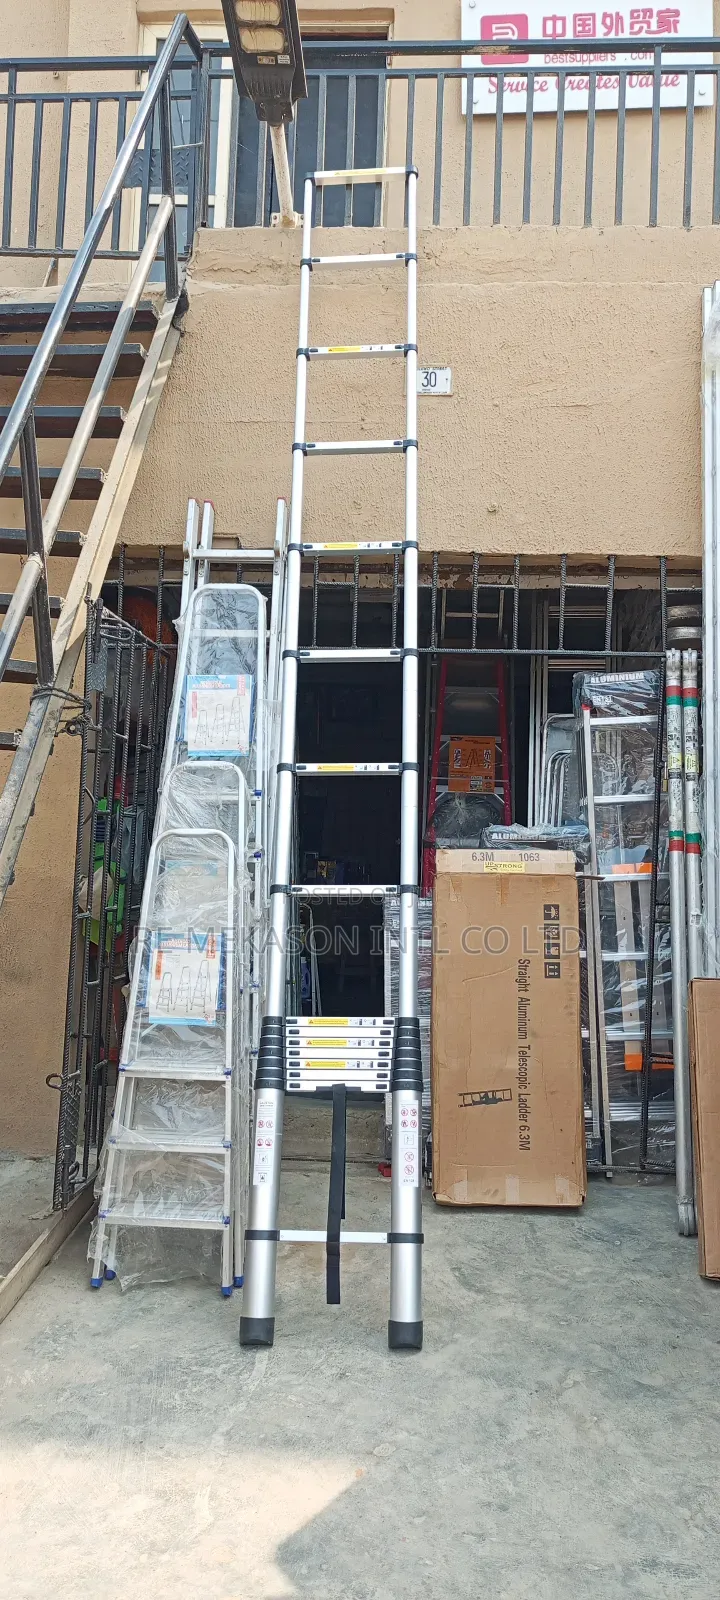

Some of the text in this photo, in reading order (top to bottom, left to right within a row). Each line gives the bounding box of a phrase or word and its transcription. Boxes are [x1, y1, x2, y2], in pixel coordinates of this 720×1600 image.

[542, 8, 681, 39] 中国外贸家
[627, 73, 681, 89] Vaue
[422, 371, 436, 388] 30
[590, 672, 644, 684] ALUMINIUM
[471, 852, 540, 863] 6.3M 1063
[515, 958, 531, 1151] Straight Aluminum Telescopic Ladder 6.3M
